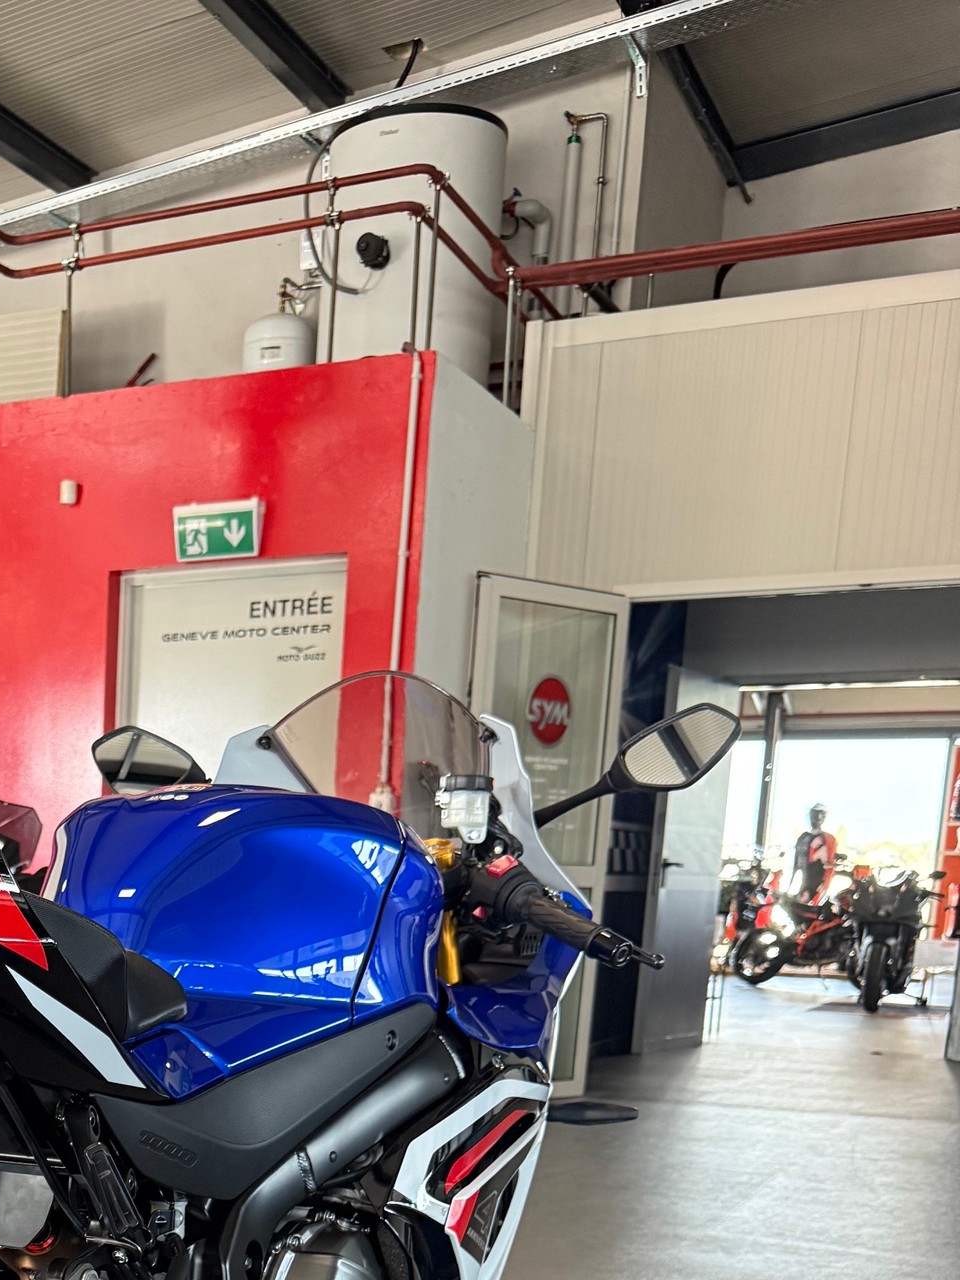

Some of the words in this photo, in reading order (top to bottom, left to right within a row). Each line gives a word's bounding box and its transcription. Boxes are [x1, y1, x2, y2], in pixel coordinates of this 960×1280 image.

[249, 590, 333, 619] ENTRÉE
[162, 630, 219, 642] GENEVE
[222, 627, 267, 639] MOTO
[271, 624, 332, 636] CENTER
[526, 698, 569, 730] SYM
